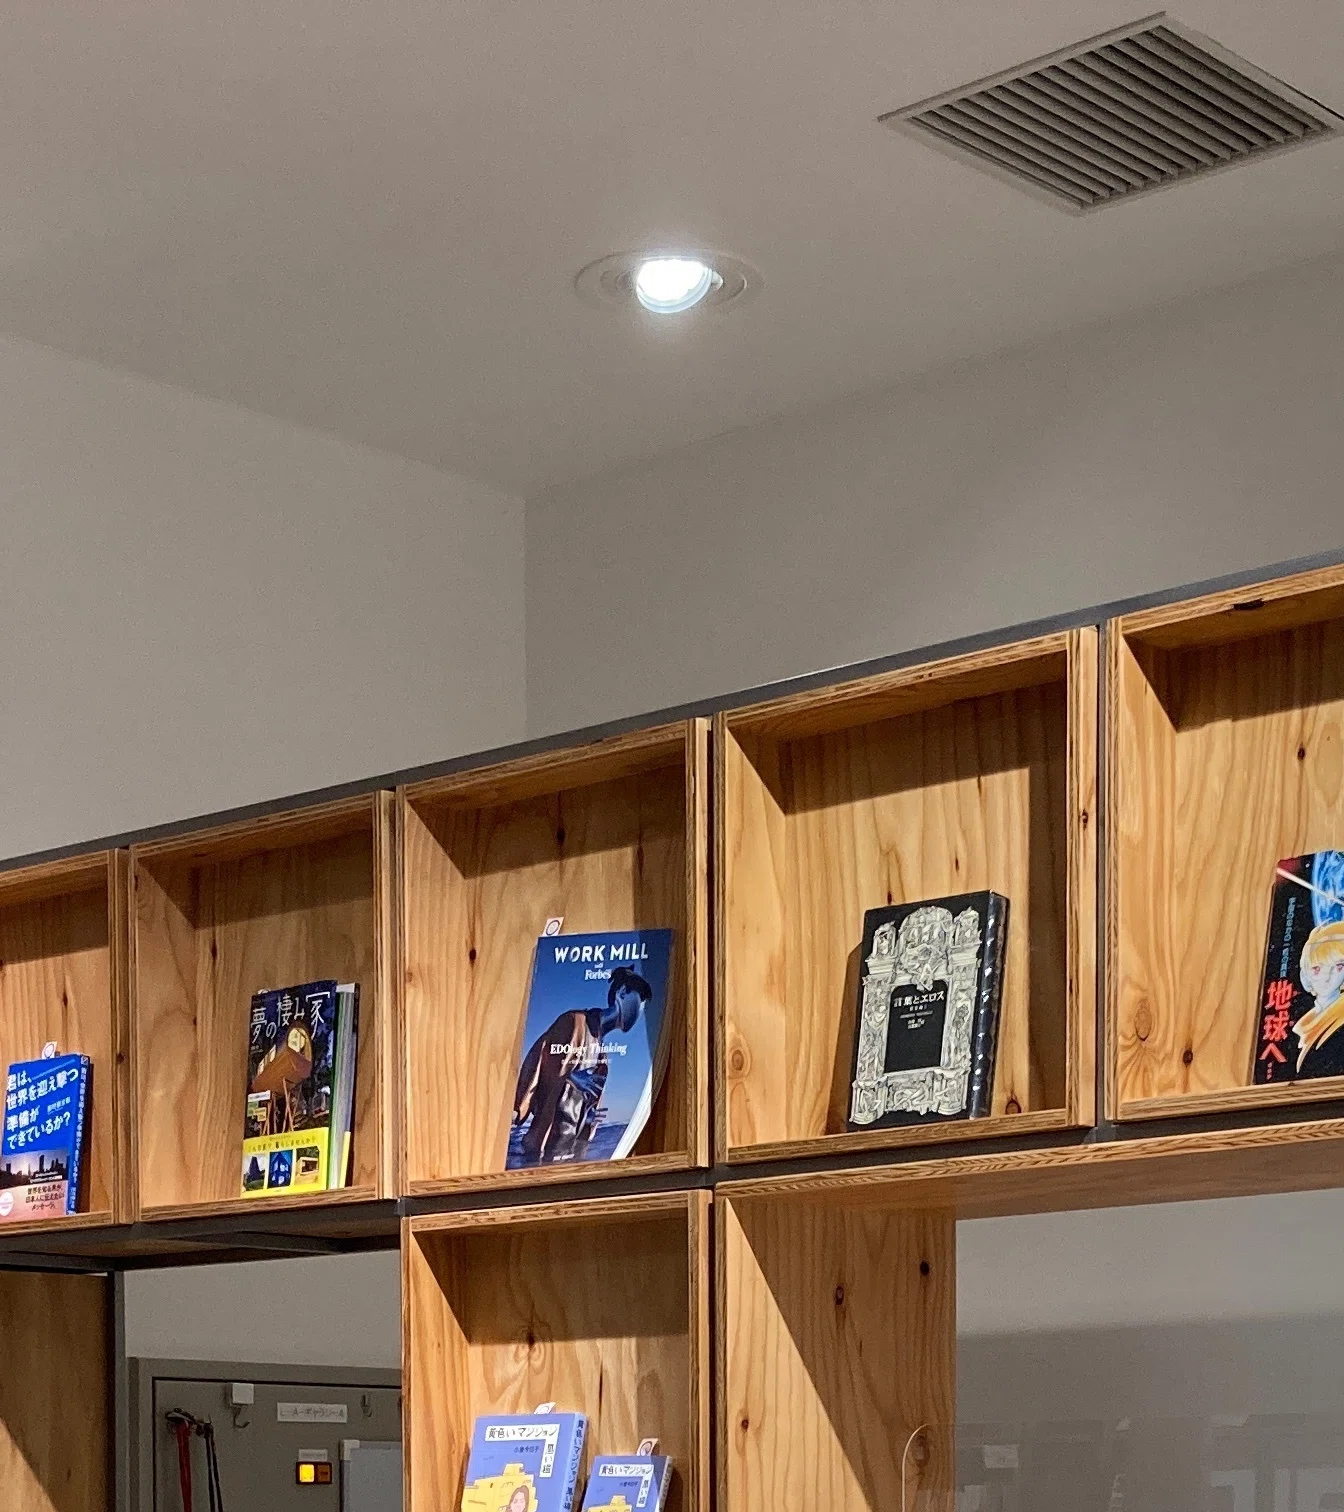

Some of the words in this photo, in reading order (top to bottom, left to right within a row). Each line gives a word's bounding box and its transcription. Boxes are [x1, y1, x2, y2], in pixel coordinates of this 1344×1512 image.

[554, 944, 606, 963] WORK
[610, 942, 649, 961] MILL
[584, 969, 612, 981] Forbes
[590, 1042, 628, 1056] Thinking
[7, 1068, 79, 1111] 世界を迎え撃つ
[7, 1105, 41, 1132] 準備が
[488, 1427, 557, 1439] 黄色いマンション
